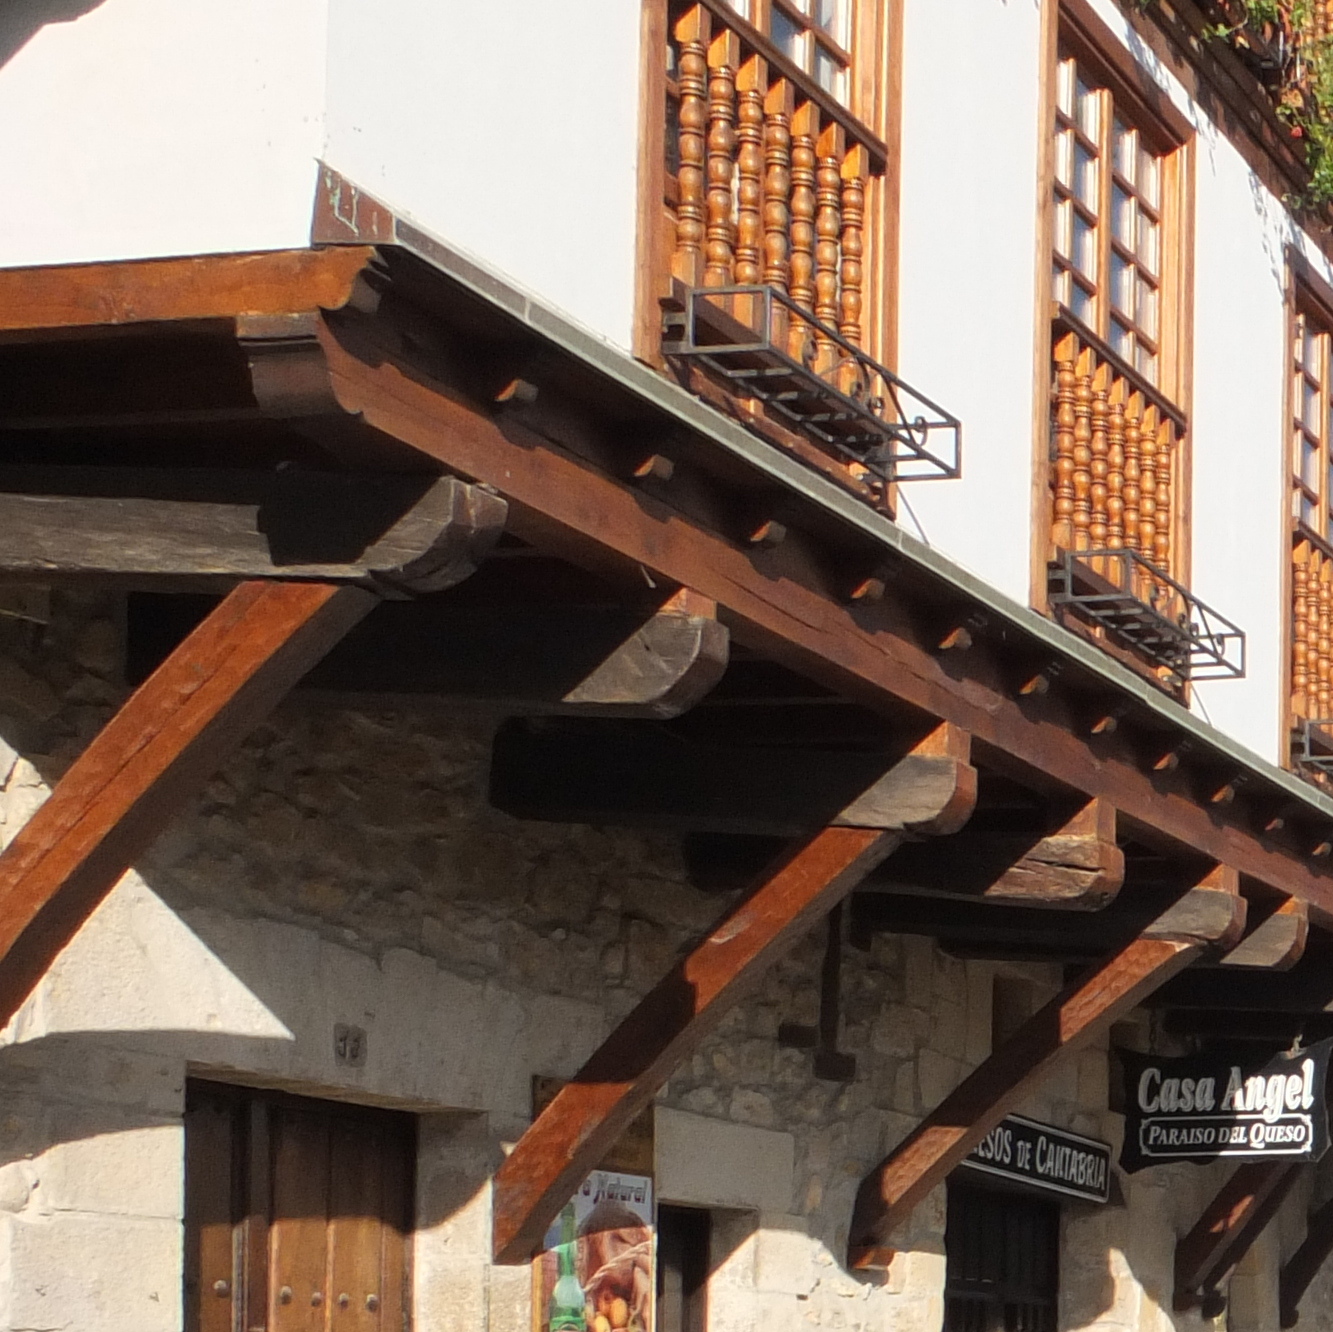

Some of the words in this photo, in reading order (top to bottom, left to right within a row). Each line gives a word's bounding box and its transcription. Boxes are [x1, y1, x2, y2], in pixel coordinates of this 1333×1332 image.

[1138, 1067, 1216, 1113] Casa
[1220, 1059, 1315, 1123] Angel
[1149, 1125, 1216, 1145] PARAISO
[1218, 1125, 1247, 1144] DEL
[1250, 1122, 1306, 1149] QUESO
[1016, 1139, 1032, 1171] DE
[1036, 1135, 1106, 1191] CANTABRIA
[594, 1174, 647, 1204] Natural
